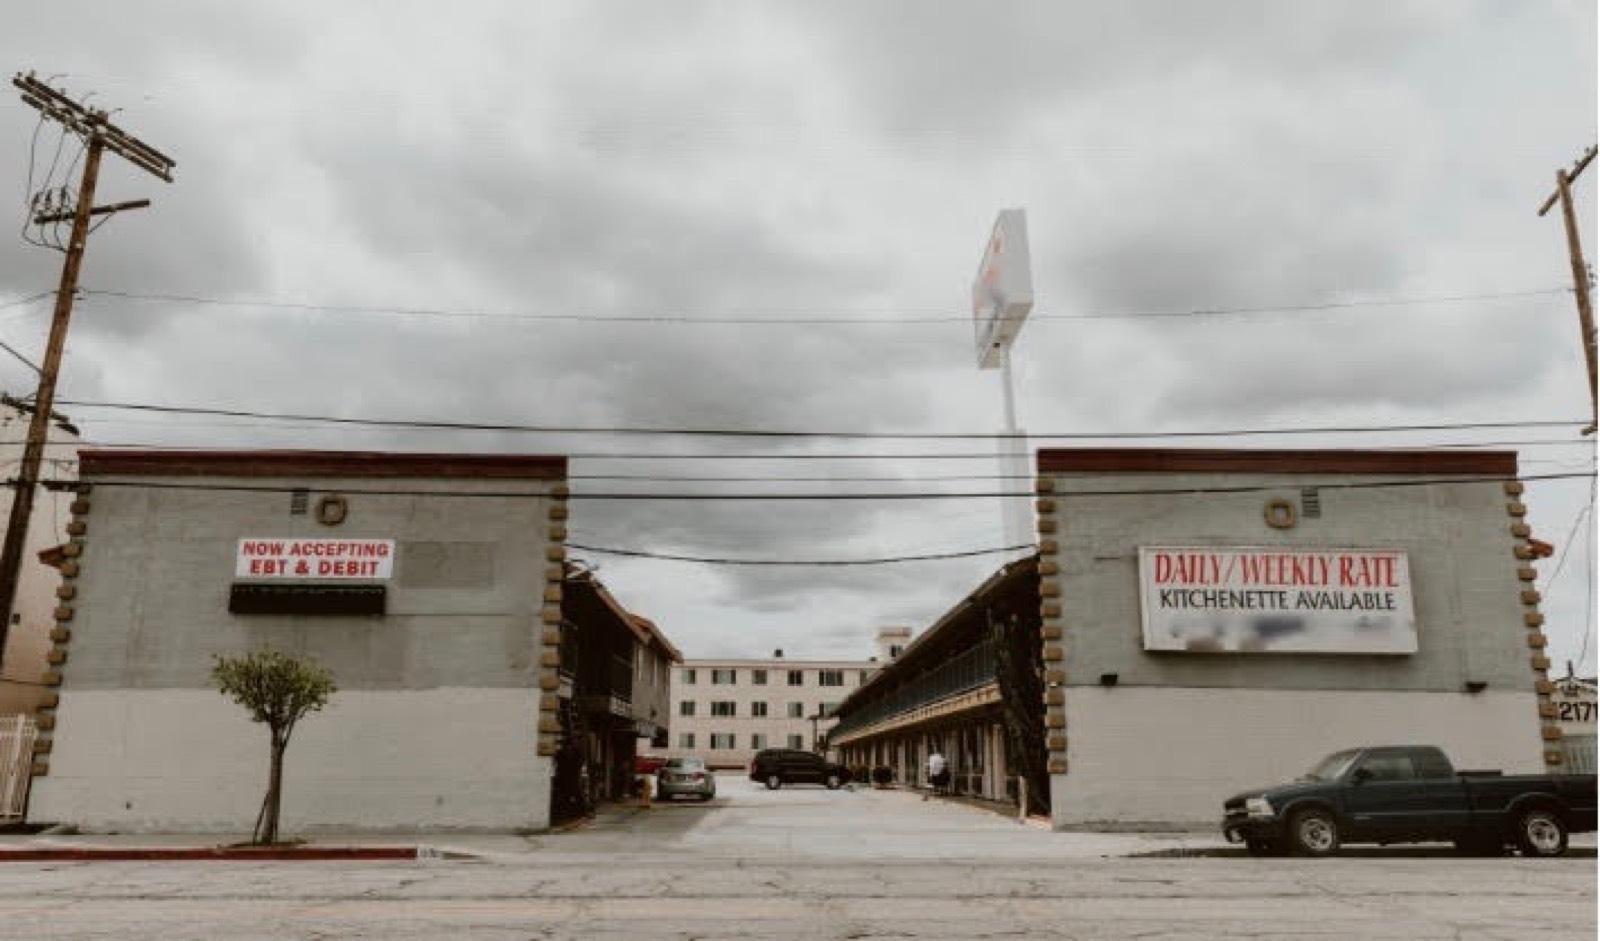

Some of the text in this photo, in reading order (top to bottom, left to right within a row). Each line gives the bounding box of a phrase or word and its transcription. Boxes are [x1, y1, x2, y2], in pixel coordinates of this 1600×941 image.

[243, 542, 388, 556] NOW ACCEPTING
[250, 559, 379, 575] EBT & DEBIT
[1339, 556, 1399, 587] RATE
[1160, 589, 1396, 611] KITCHENETTE AVAILABLE
